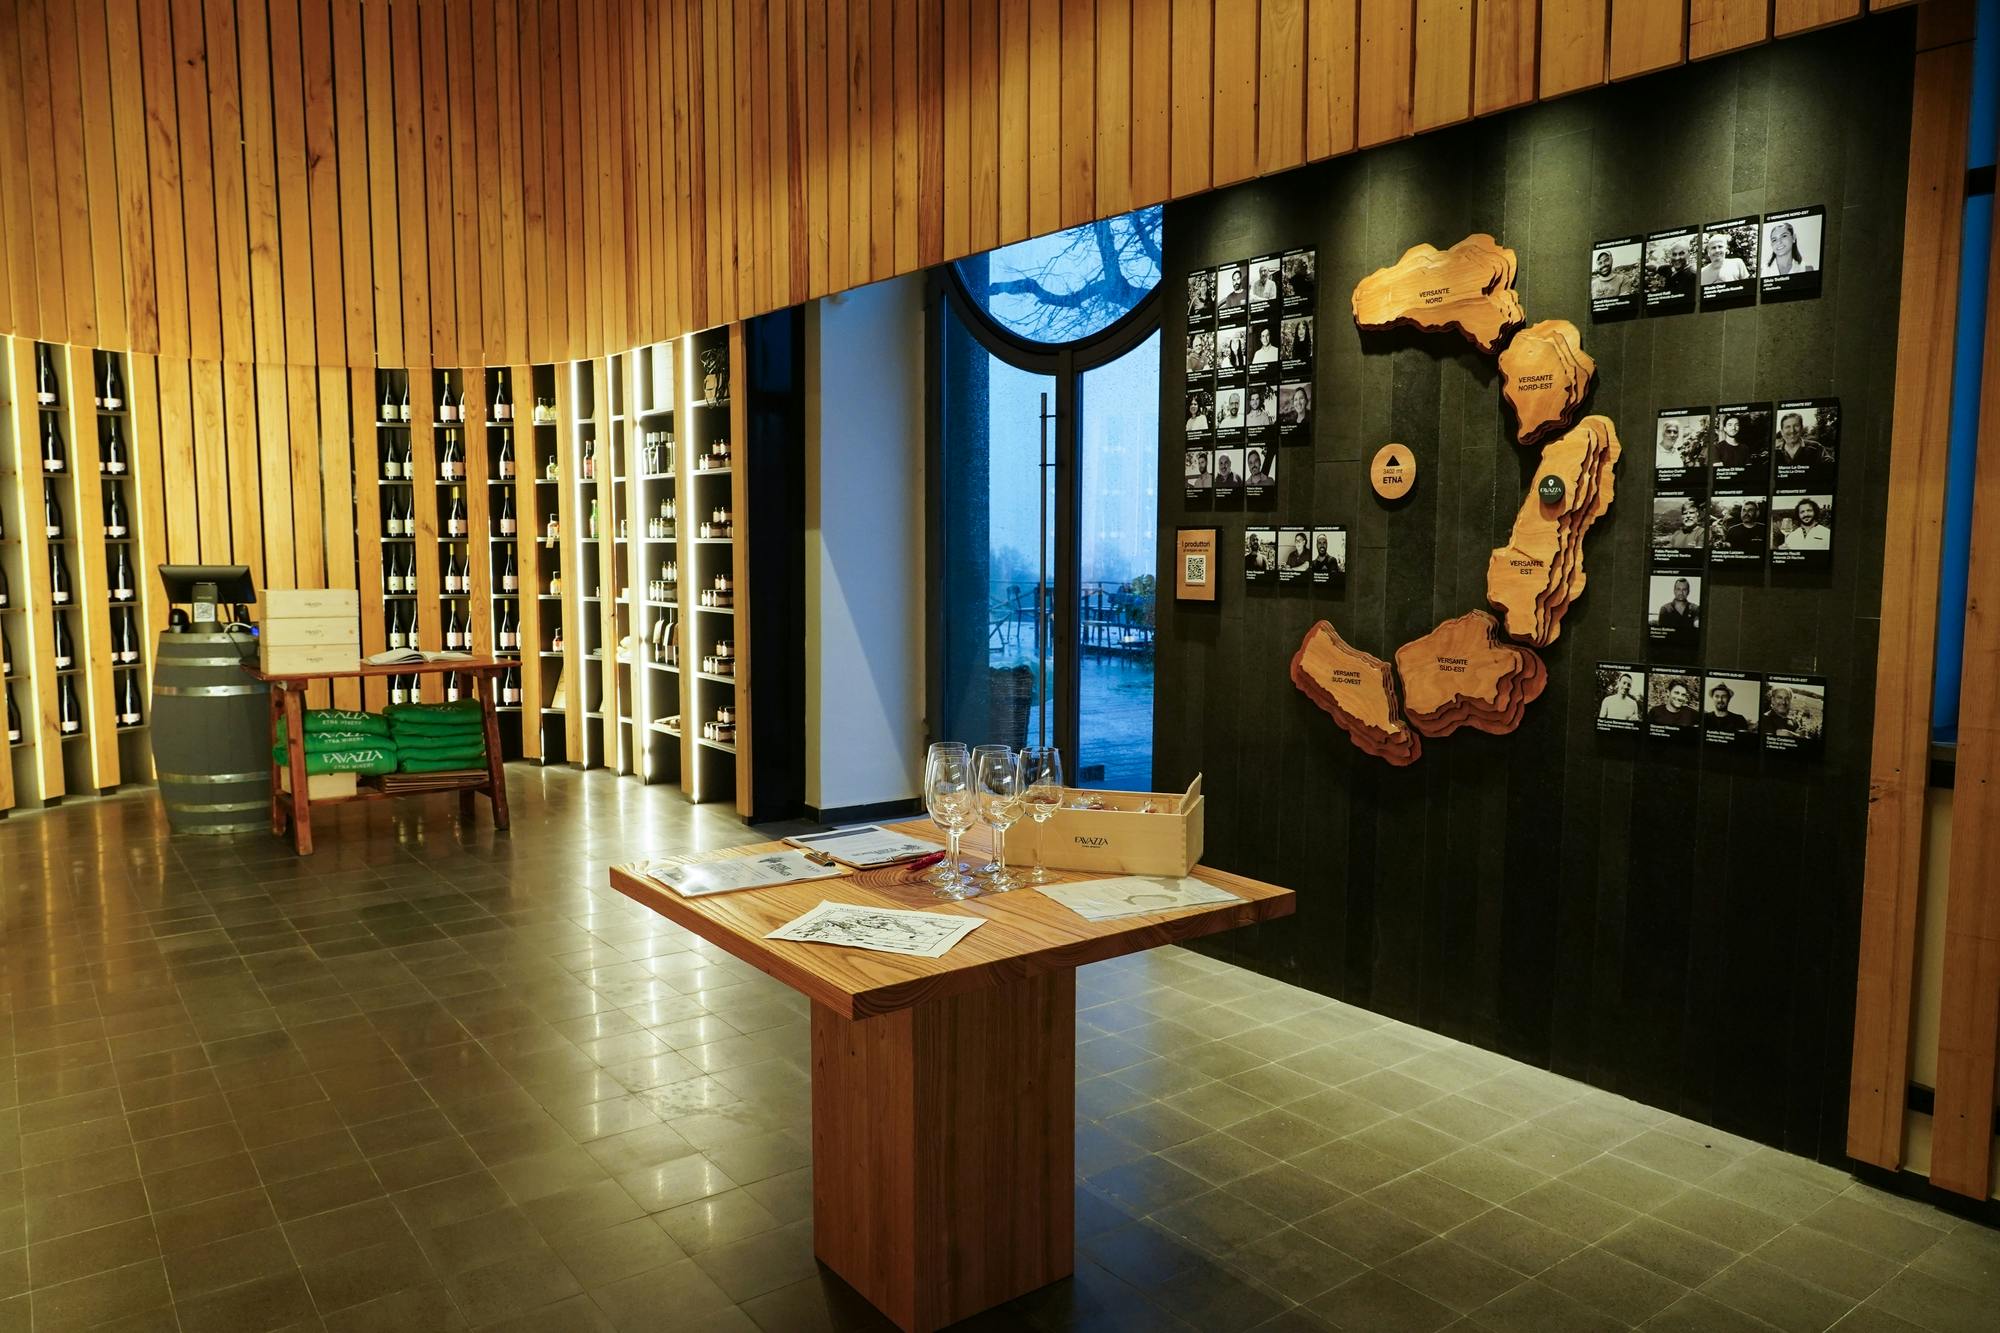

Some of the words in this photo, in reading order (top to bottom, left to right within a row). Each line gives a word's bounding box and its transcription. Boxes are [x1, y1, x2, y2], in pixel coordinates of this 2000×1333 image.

[1419, 287, 1450, 298] VERSANTE
[1518, 374, 1553, 383] VERSANTE
[1518, 382, 1553, 392] NORD-EST
[1383, 476, 1403, 484] ETNA
[1510, 560, 1543, 568] VERSANTE
[1437, 656, 1468, 665] VERSANTE
[1440, 665, 1465, 673] SUD-EST
[1333, 670, 1360, 678] VERSANTE
[323, 750, 383, 763] FAVAZZA
[1074, 836, 1109, 846] FAVAZZA
